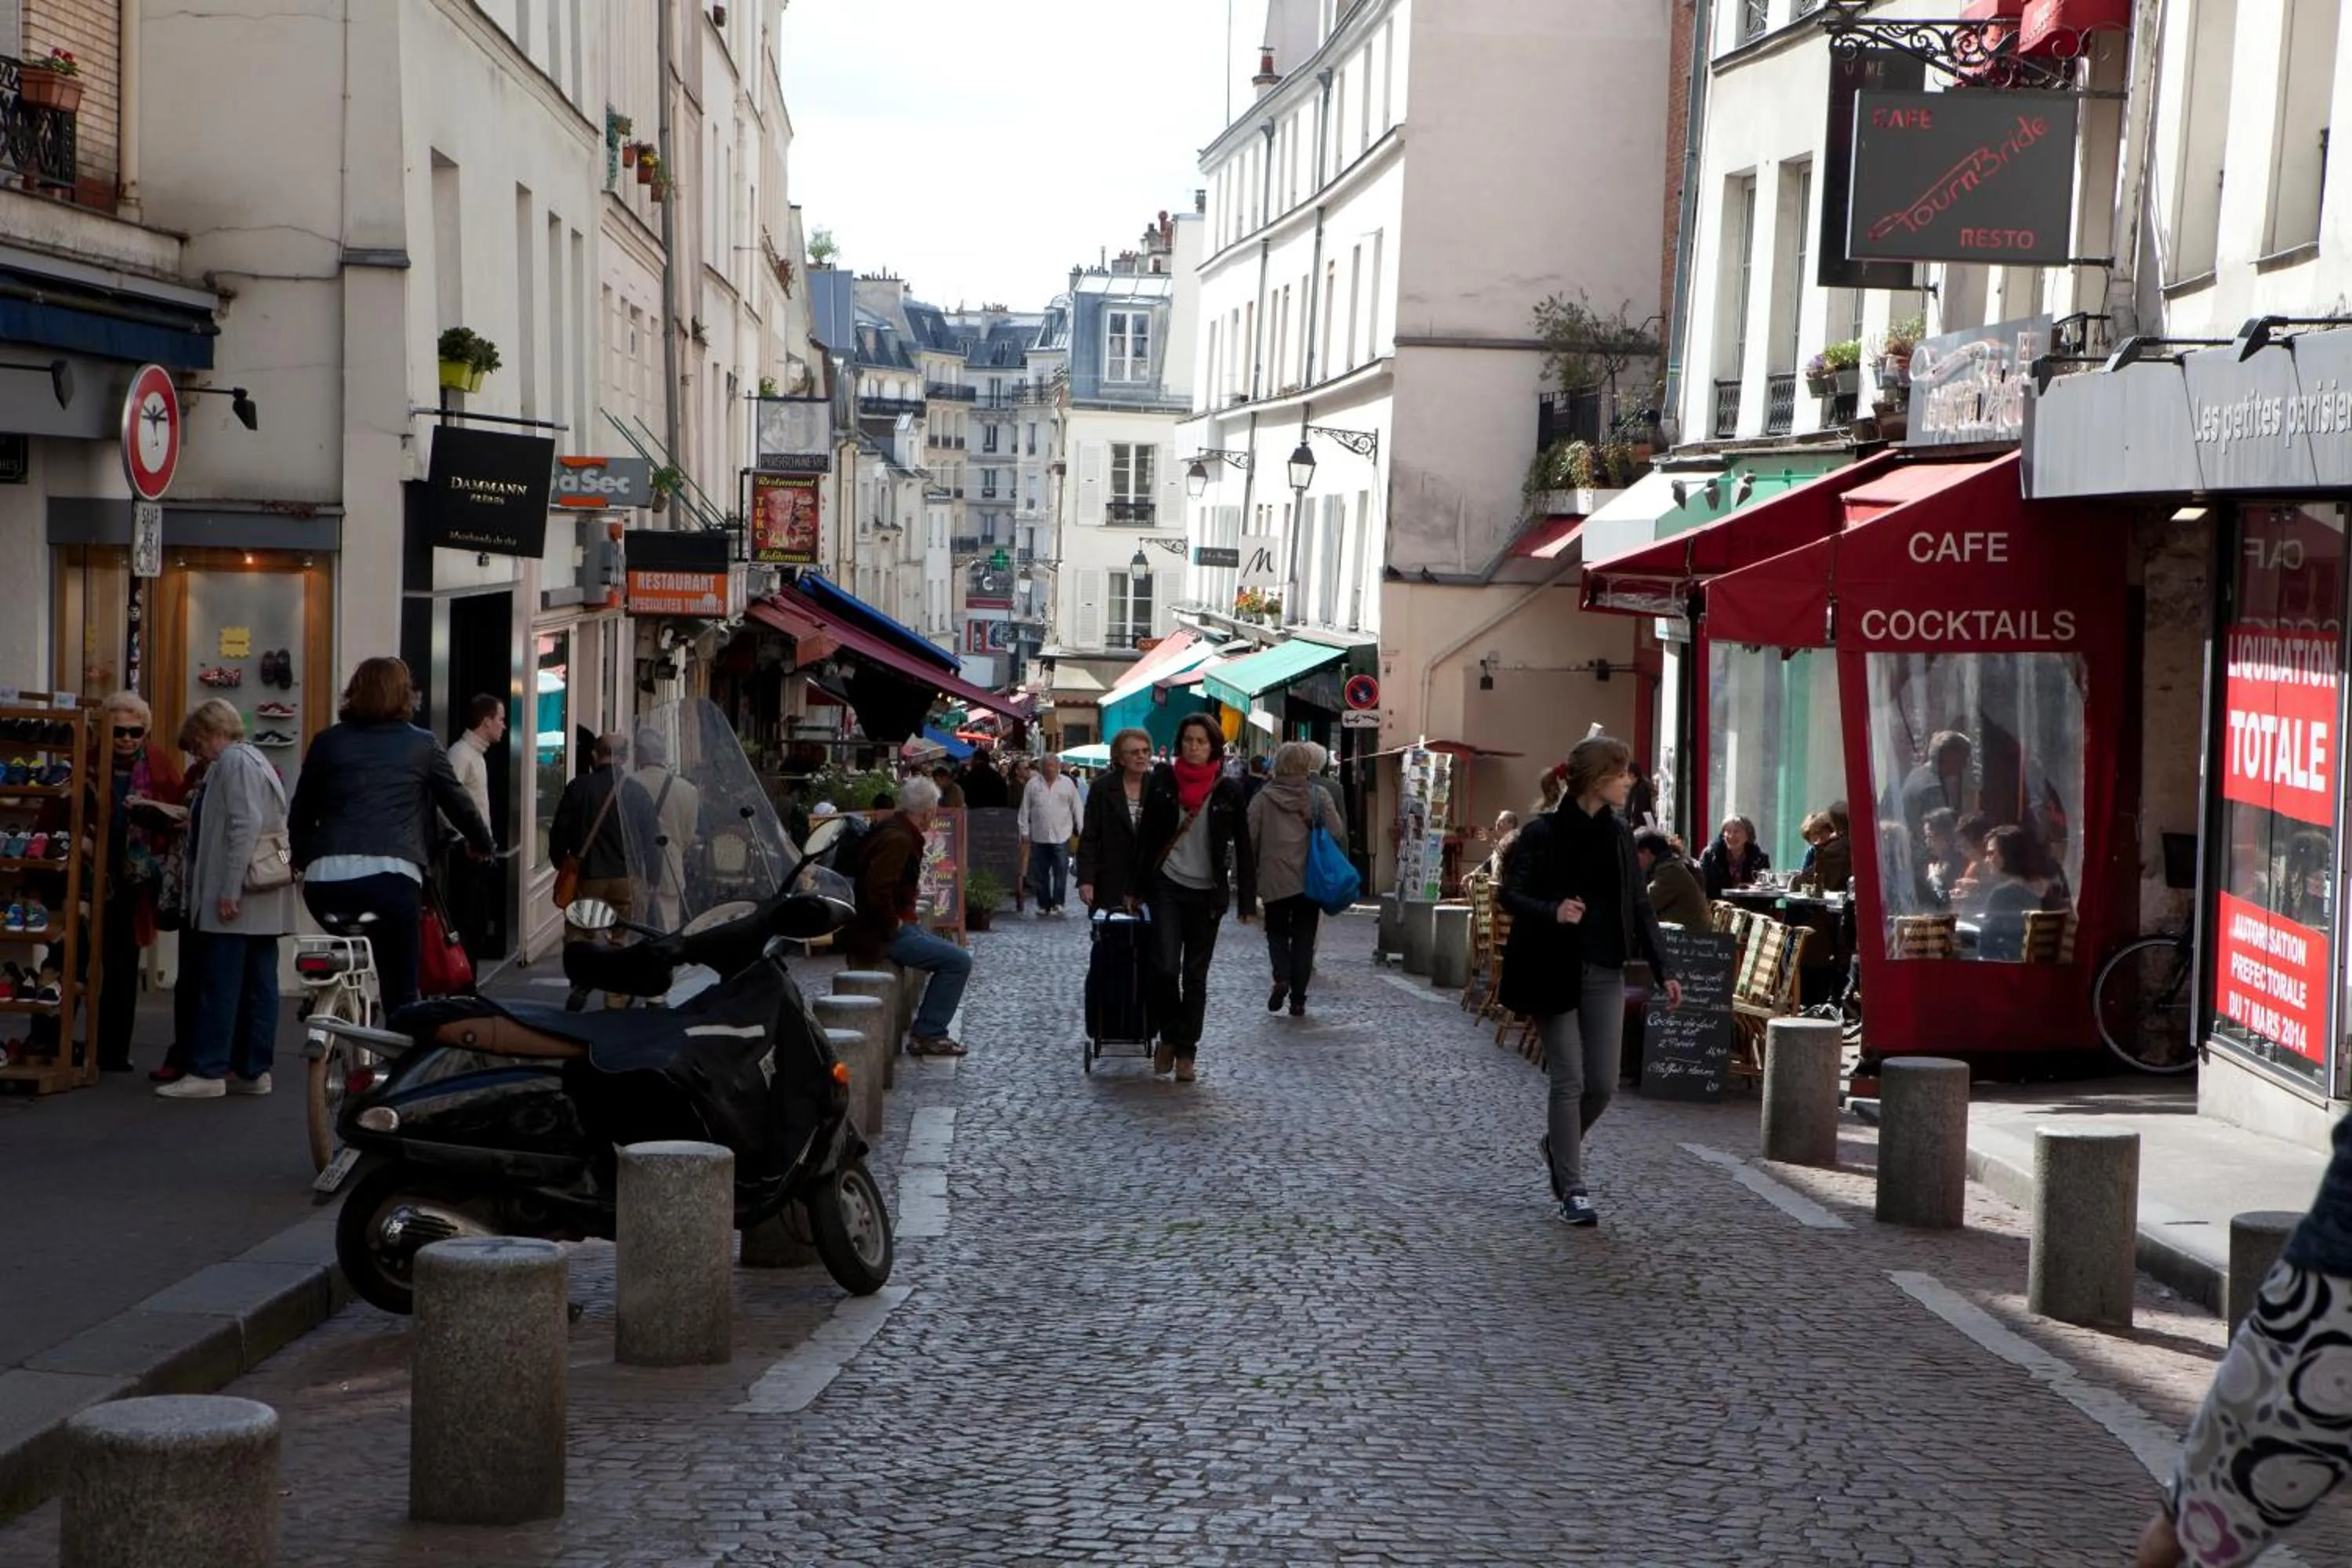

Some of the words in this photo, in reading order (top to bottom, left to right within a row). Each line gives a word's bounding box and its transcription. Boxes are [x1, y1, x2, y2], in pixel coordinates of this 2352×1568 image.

[1960, 228, 2035, 249] RESTO
[2194, 396, 2220, 443] Les
[2223, 388, 2282, 455] petites
[451, 476, 528, 495] DAMMANN
[1908, 532, 2009, 563] CAFE
[637, 572, 716, 592] RESTAURANT
[1860, 609, 2076, 641] COCKTAILS
[2227, 633, 2338, 689] LIQUIDATION
[2230, 708, 2328, 793] TOTALE
[2231, 912, 2307, 967] AUTORISATION
[2230, 950, 2307, 1011] PREFECTORALE
[2227, 990, 2243, 1021] DU
[2243, 996, 2251, 1025] 7
[2251, 1000, 2281, 1040] MARS
[2281, 1016, 2307, 1054] 2014
